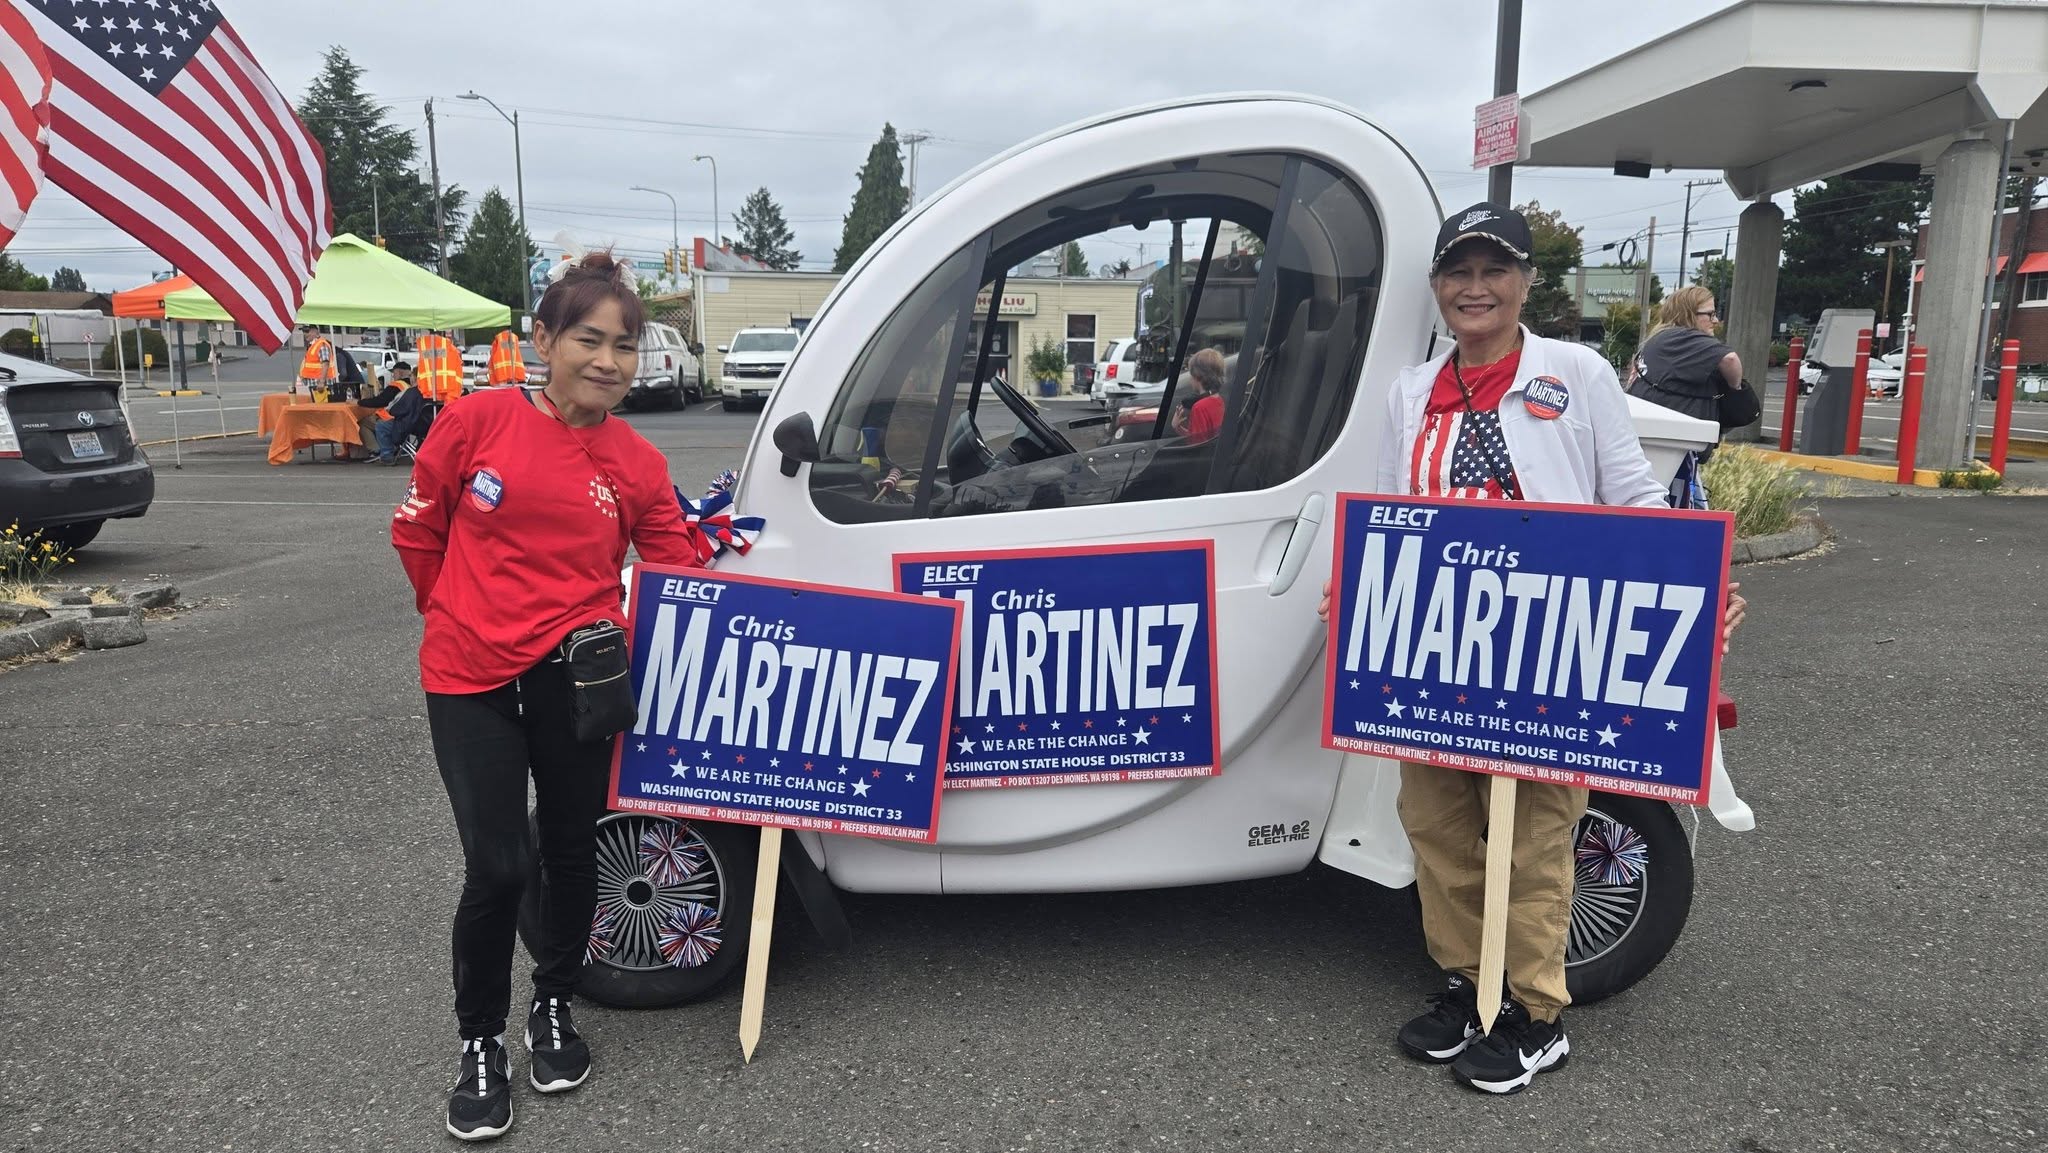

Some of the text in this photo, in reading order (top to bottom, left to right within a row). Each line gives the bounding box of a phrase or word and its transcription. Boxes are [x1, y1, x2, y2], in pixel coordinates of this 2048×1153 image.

[1477, 119, 1516, 139] AIRPORT
[1003, 297, 1025, 305] LIU
[1526, 379, 1568, 407] MARTINEZ
[596, 484, 615, 504] US
[1369, 506, 1438, 528] ELECT
[1442, 541, 1520, 568] Chris
[923, 564, 983, 583] ELECT
[663, 578, 726, 601] ELECT
[991, 588, 1056, 611] Chris
[728, 615, 795, 641] Chris
[1344, 532, 1706, 712] MARTINEZ
[632, 603, 940, 765] MARTINEZ
[1412, 706, 1589, 742] WE ARE THE CHANGE
[982, 734, 1127, 752] WE ARE THE CHANGE
[1355, 721, 1663, 776] WASHINGTON STATE HOUSE DISTRICT 33
[944, 751, 1185, 772] ASHINGTON STATE HOUSE DISTRICT 33
[1332, 736, 1698, 802] PAID FOR BY ELECT MARTINEZ PO BOX 13207 DES MOINES, WA 98198 PREFERS REPUBLICAN PARTY
[695, 766, 846, 794] WE ARE THE CHANGE
[952, 779, 970, 788] ELECT
[970, 778, 1002, 788] MARTINEZ
[1008, 777, 1017, 786] PO
[1018, 777, 1030, 786] BOX
[1032, 776, 1050, 785] 13207
[1051, 775, 1063, 784] DES
[1064, 773, 1089, 784] MOINES,
[1090, 773, 1100, 782] WA
[1101, 772, 1120, 782] 98198
[1127, 770, 1154, 780] PREFERS
[1154, 768, 1193, 779] REPUBLICAN
[1193, 766, 1213, 777] PARTY
[640, 782, 902, 820] WASHINGTON STATE HOUSE DISTRICT 33
[618, 798, 928, 840] PAID FOR BY ELECT MARTINEZ PO BOX 13207 DES MOINES, WA 98198 PREFERS REPUBLICAN PARTY
[1248, 820, 1310, 838] GEM e2
[1248, 832, 1310, 847] ELECTRIC
